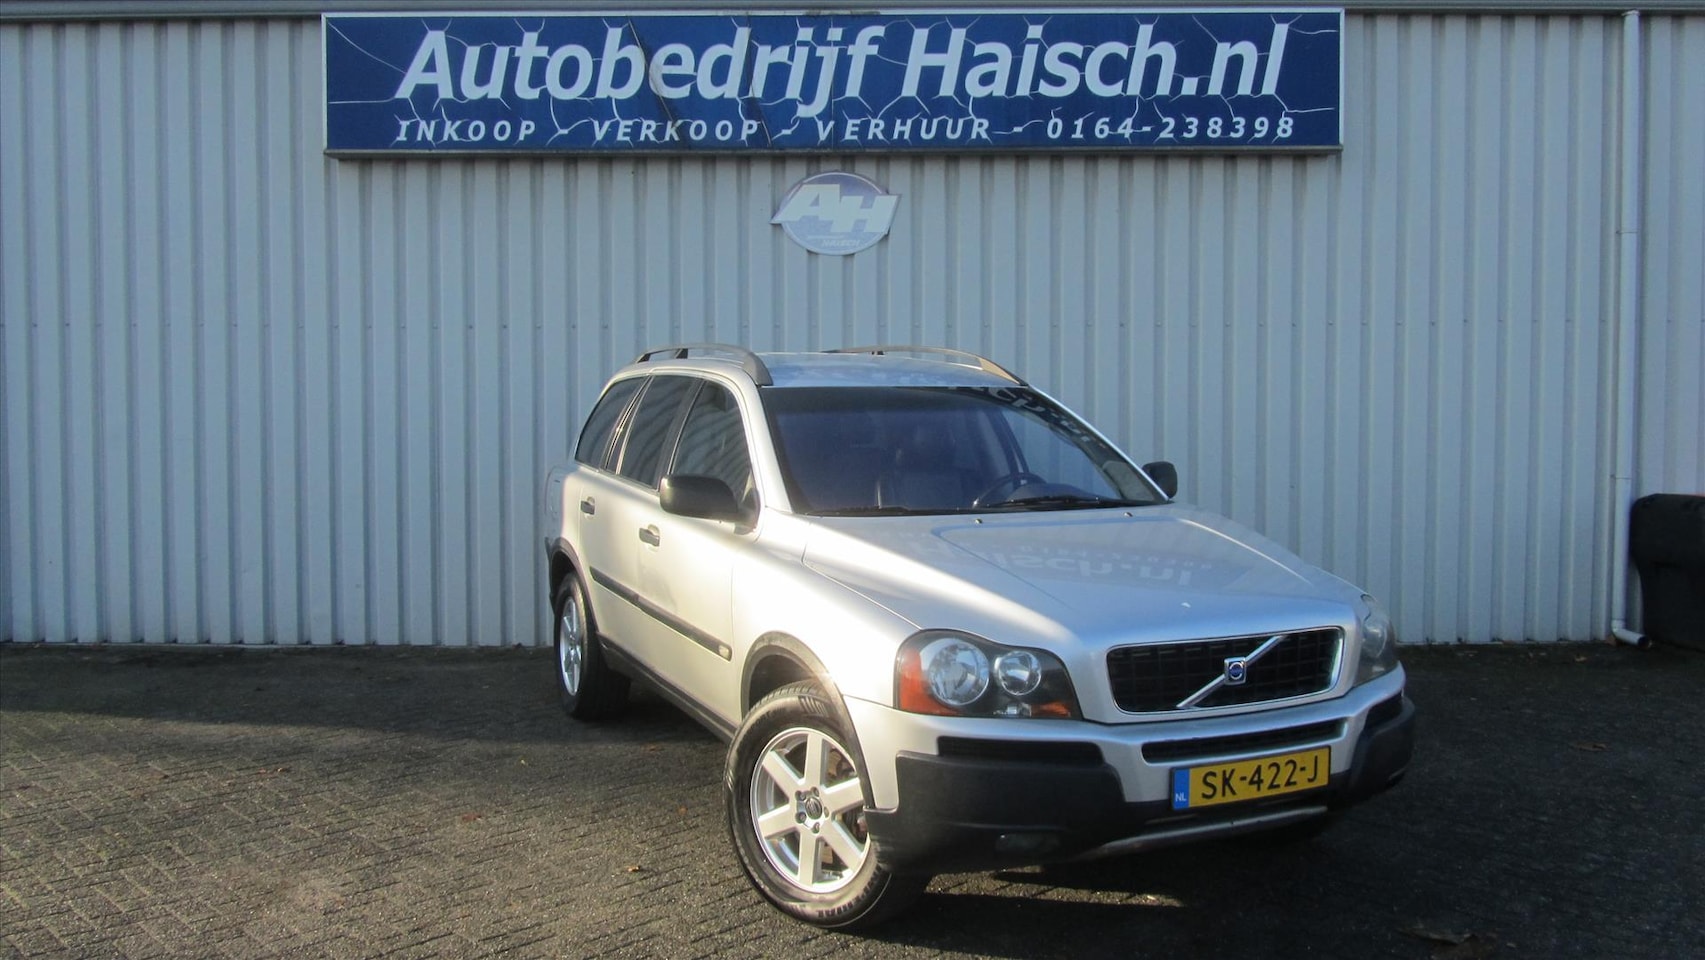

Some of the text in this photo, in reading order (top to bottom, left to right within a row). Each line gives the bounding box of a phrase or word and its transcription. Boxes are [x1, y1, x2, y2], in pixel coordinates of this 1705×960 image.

[394, 23, 1289, 118] Autobedrijf Haisch.nl
[396, 120, 536, 142] INKOOP
[593, 120, 758, 142] VERKOOP
[817, 117, 990, 141] VERHUUR
[1047, 116, 1294, 139] 0164-238398
[770, 184, 899, 233] AH
[1175, 793, 1187, 802] NL
[1201, 755, 1319, 800] SK-422-J
